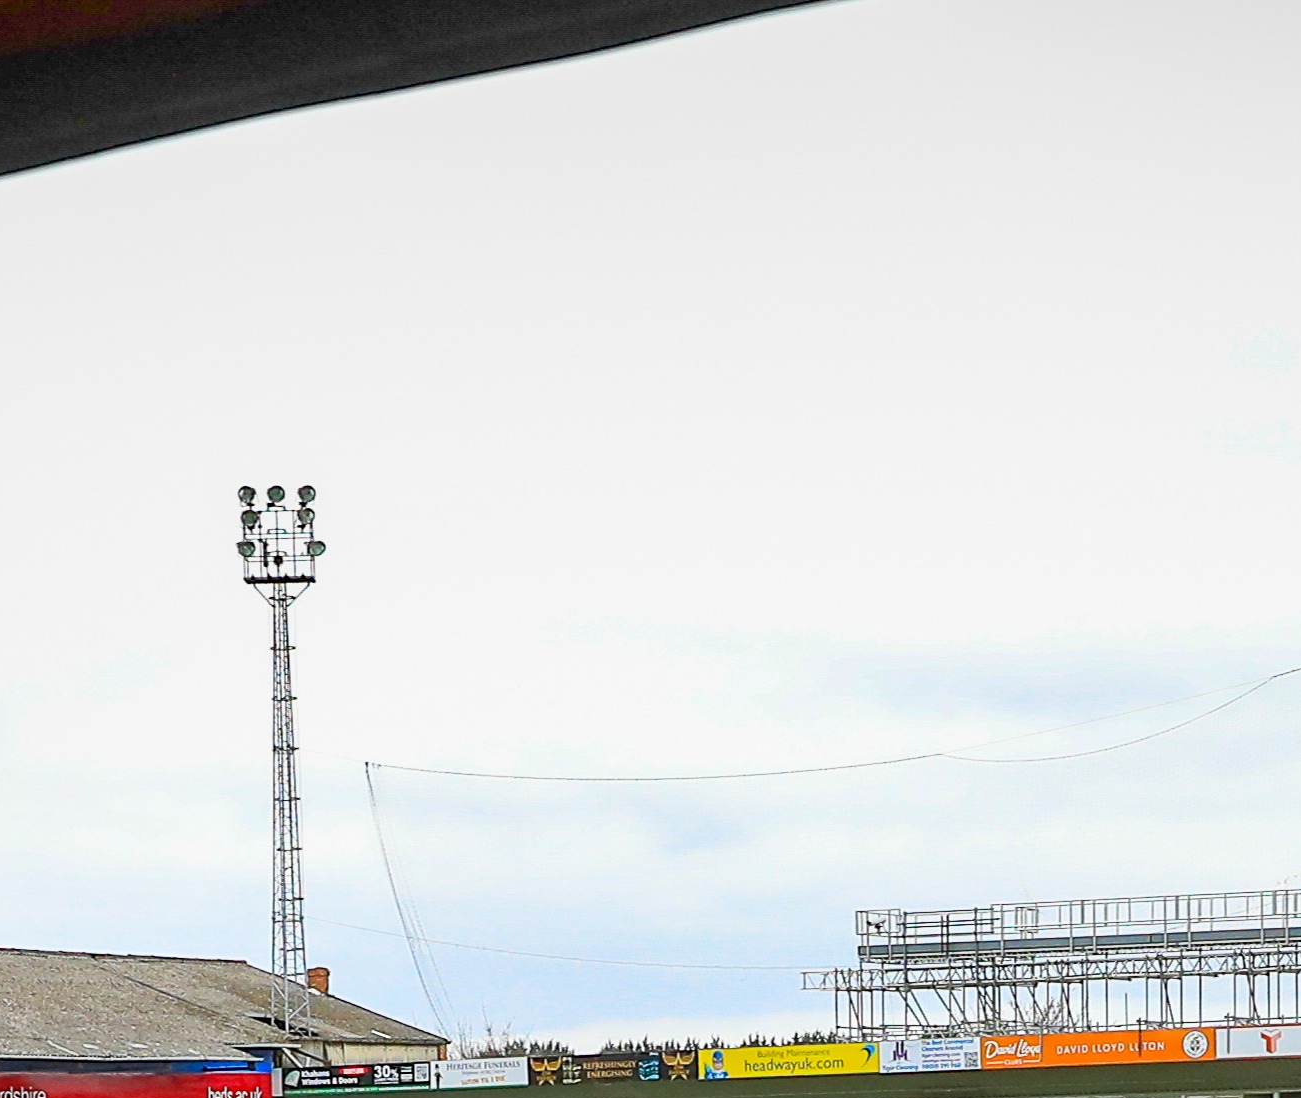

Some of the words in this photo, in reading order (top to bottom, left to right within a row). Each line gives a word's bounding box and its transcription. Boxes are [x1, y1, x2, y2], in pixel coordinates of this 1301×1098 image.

[1056, 1043, 1088, 1055] DAVID
[1093, 1042, 1124, 1054] LLOYD
[374, 1065, 399, 1079] 30%
[744, 1057, 844, 1074] headwayuk.com
